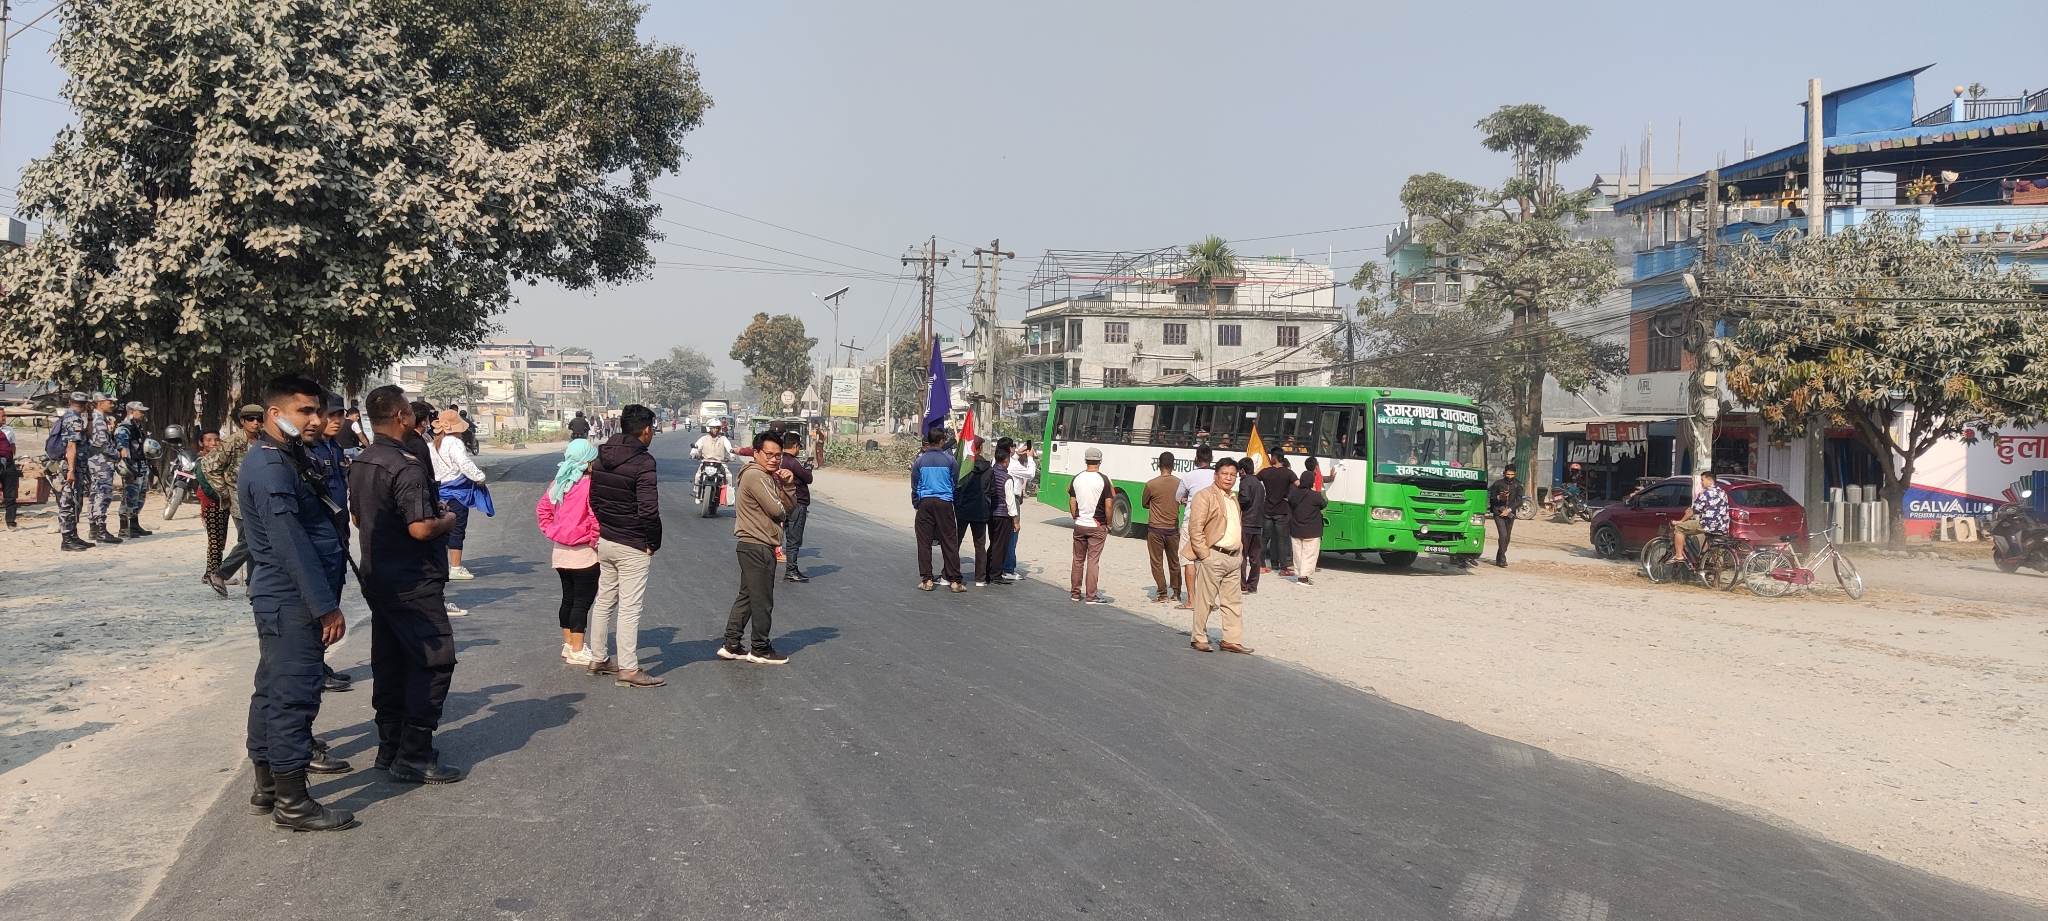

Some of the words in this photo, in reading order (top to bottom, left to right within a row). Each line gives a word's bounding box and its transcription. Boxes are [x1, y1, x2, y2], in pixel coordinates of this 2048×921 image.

[1384, 404, 1438, 419] सगरमाथा
[1441, 408, 1478, 425] यातायात
[1151, 457, 1195, 473] समाथा
